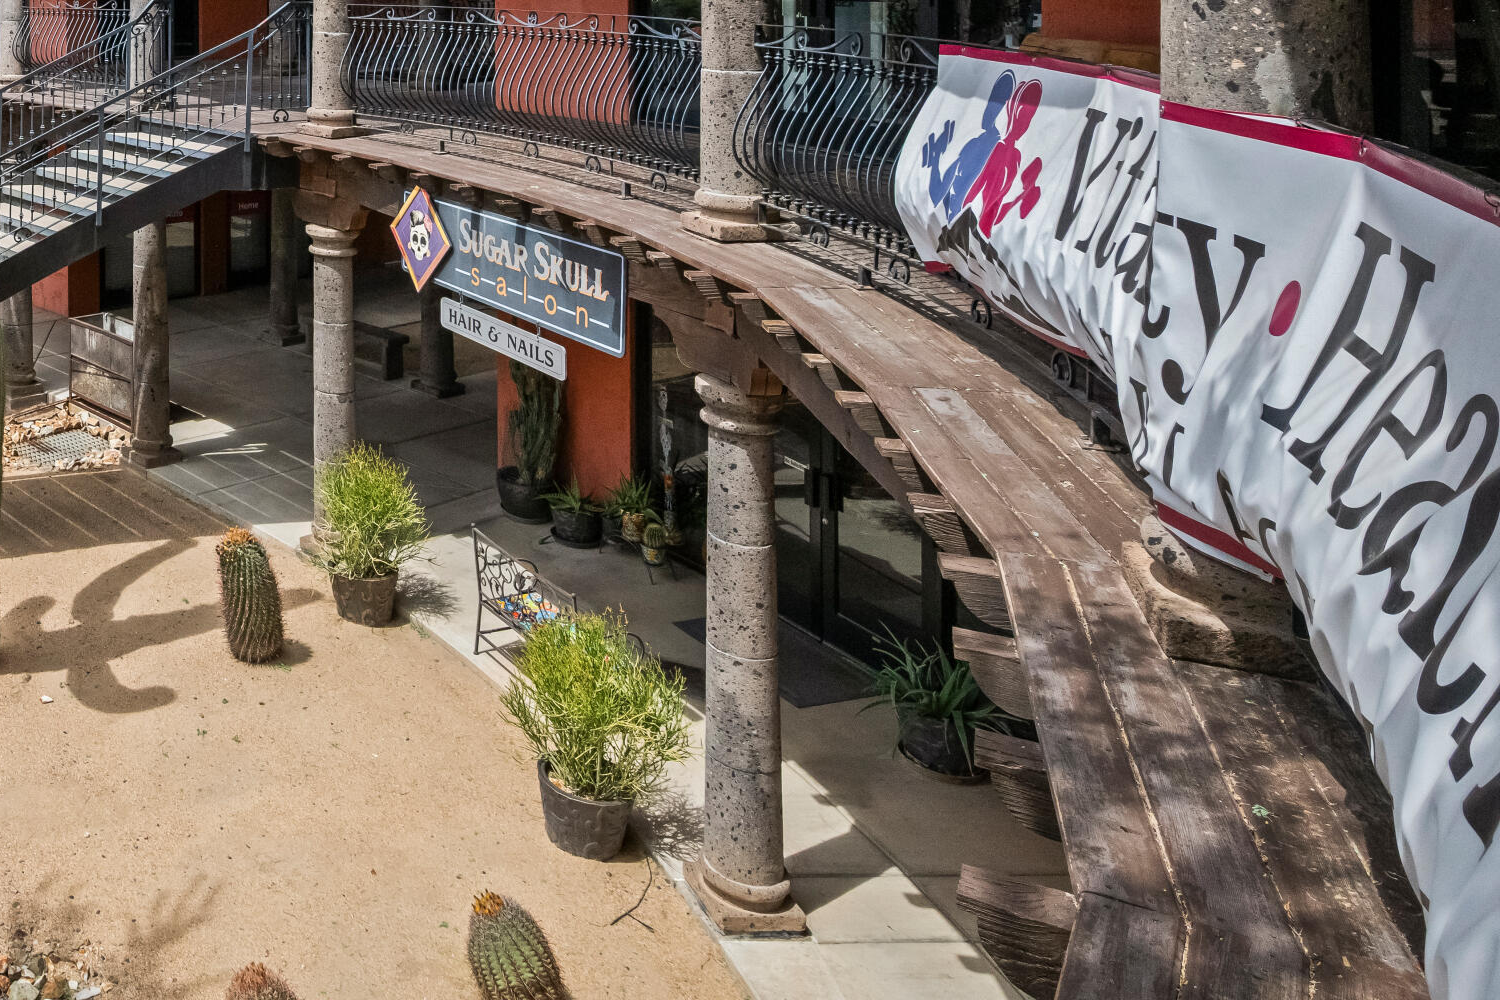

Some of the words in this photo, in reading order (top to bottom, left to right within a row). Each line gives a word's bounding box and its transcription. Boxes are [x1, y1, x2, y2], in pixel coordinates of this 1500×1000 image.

[238, 202, 259, 210] Home
[458, 218, 531, 279] SUGAR
[533, 241, 610, 302] SKULL
[449, 308, 483, 336] HAIR
[488, 326, 502, 343] &
[507, 334, 554, 368] NAILS
